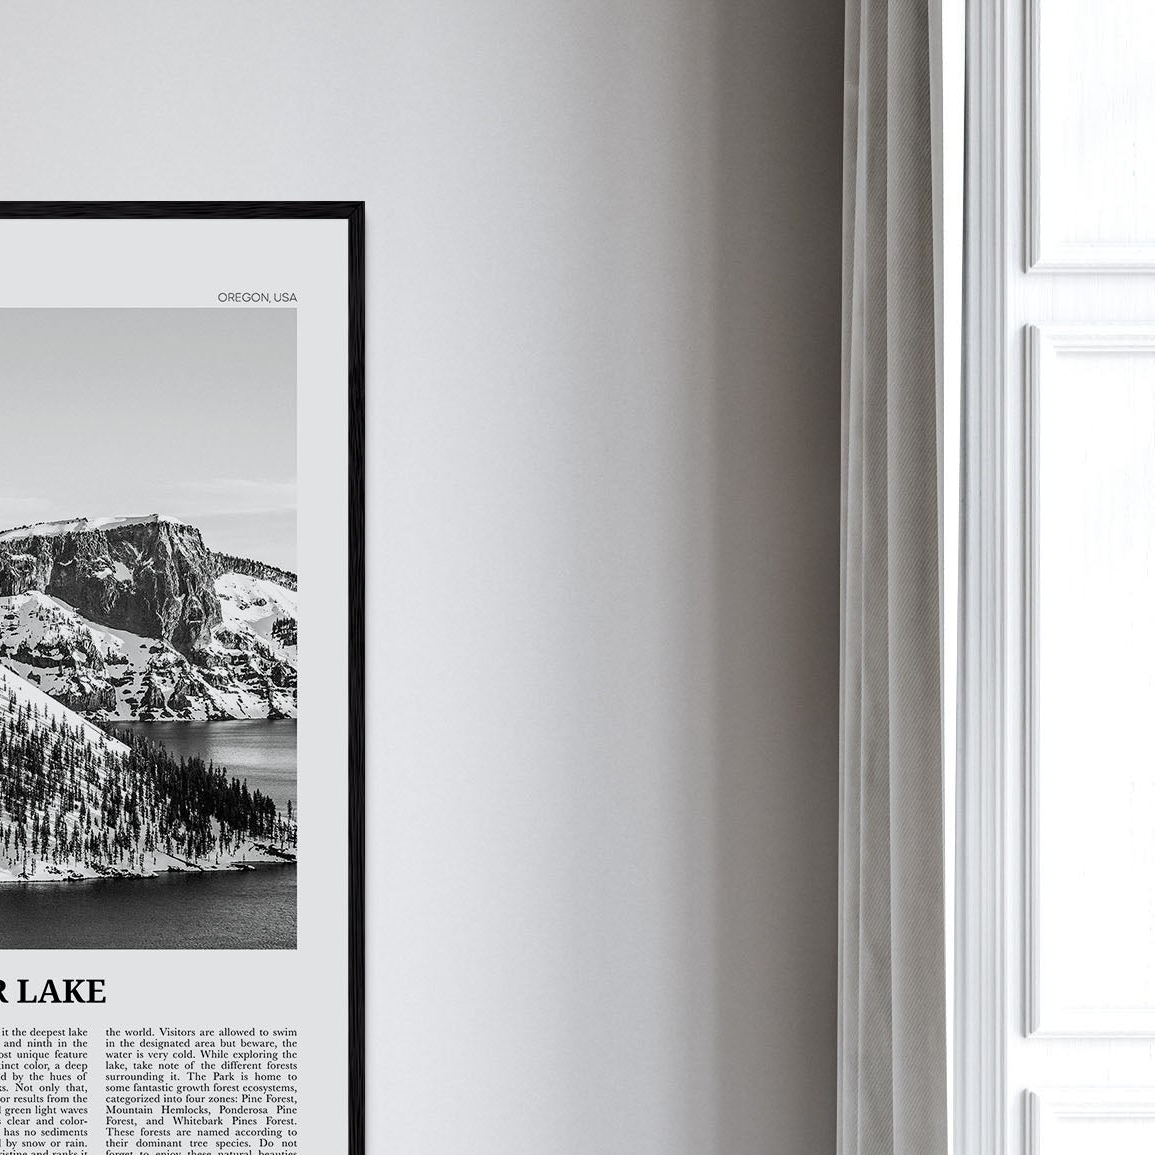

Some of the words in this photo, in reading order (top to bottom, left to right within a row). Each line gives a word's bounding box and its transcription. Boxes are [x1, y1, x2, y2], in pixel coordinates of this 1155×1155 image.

[217, 292, 272, 304] OREGON,
[273, 292, 298, 303] USA
[16, 978, 107, 1004] LAKE
[2, 1027, 9, 1037] it
[12, 1027, 27, 1037] the
[29, 1027, 65, 1039] deepest
[68, 1027, 88, 1037] lake
[106, 1027, 121, 1037] the
[124, 1027, 155, 1037] world.
[159, 1027, 196, 1037] Visitors
[199, 1029, 215, 1037] are
[218, 1027, 255, 1037] allowed
[259, 1028, 269, 1037] to
[272, 1027, 297, 1037] swim
[17, 1049, 50, 1061] unique
[55, 1049, 88, 1059] feature
[105, 1051, 133, 1059] water
[136, 1049, 144, 1059] is
[148, 1052, 169, 1061] very
[172, 1049, 196, 1059] cold.
[200, 1049, 229, 1059] While
[232, 1049, 278, 1061] exploring
[282, 1049, 297, 1059] the
[105, 1072, 164, 1084] surrounding
[170, 1072, 180, 1081] it.
[186, 1072, 207, 1081] The
[213, 1072, 235, 1081] Park
[241, 1072, 249, 1081] is
[255, 1072, 281, 1081] home
[288, 1073, 297, 1081] to
[15, 1083, 33, 1092] Not
[38, 1083, 60, 1095] only
[66, 1083, 88, 1094] that,
[133, 1083, 173, 1092] fantastic
[176, 1083, 210, 1095] growth
[213, 1083, 240, 1092] forest
[242, 1084, 297, 1095] ecosystems,
[4, 1107, 32, 1117] green
[35, 1105, 57, 1117] light
[60, 1107, 88, 1115] waves
[106, 1105, 153, 1115] Mountain
[161, 1105, 211, 1116] Hemlocks,
[219, 1105, 268, 1115] Ponderosa
[276, 1105, 297, 1115] Pine
[106, 1116, 137, 1127] Forest,
[146, 1116, 164, 1126] and
[173, 1116, 223, 1126] Whitebark
[232, 1116, 257, 1126] Pines
[266, 1116, 297, 1126] Forest.
[4, 1127, 20, 1137] has
[40, 1127, 88, 1137] sediments
[105, 1138, 129, 1148] their
[135, 1138, 182, 1148] dominant
[190, 1140, 208, 1148] tree
[215, 1138, 251, 1150] species.
[259, 1138, 274, 1148] Do
[281, 1140, 297, 1148] not
